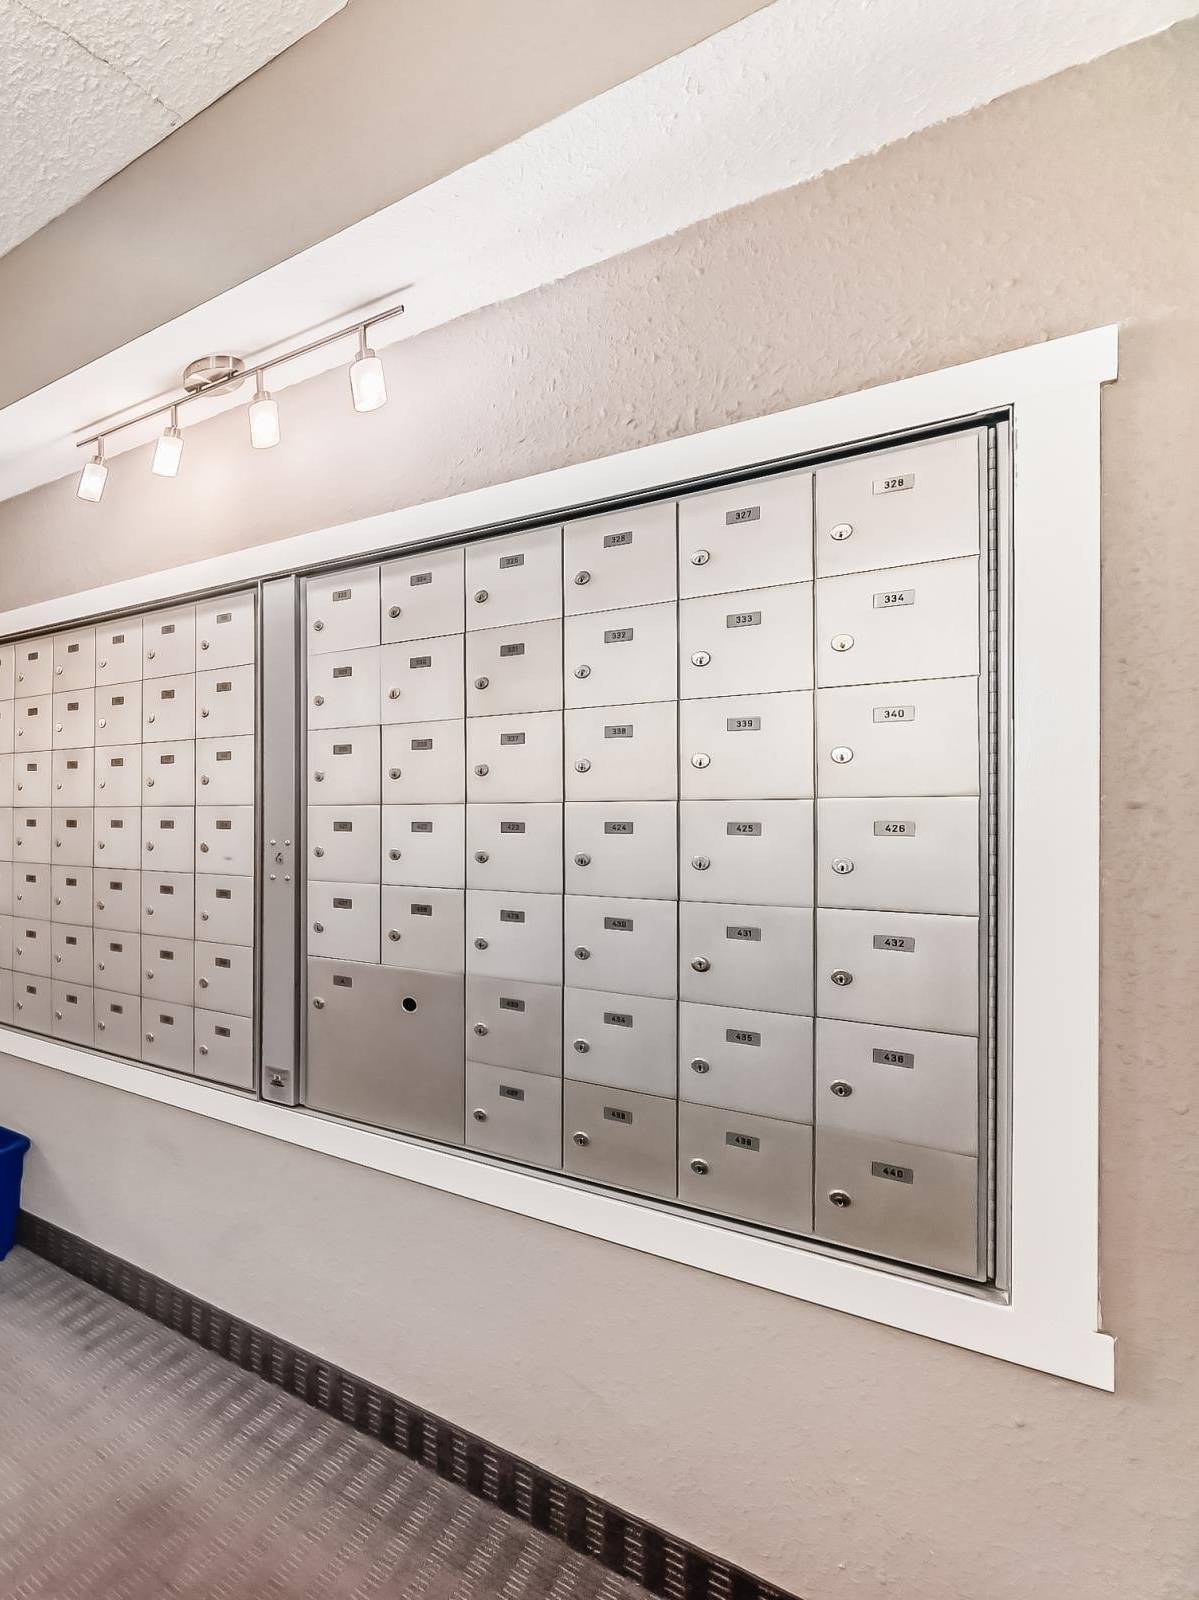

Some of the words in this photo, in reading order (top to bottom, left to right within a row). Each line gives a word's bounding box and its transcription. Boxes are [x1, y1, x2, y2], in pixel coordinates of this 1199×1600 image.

[884, 478, 904, 489] 328
[735, 510, 752, 520] 327
[884, 593, 904, 603] 334
[735, 614, 753, 624] 333
[611, 631, 626, 639] 332
[884, 709, 905, 719] 340
[736, 719, 753, 728] 339
[612, 727, 627, 735] 338
[611, 823, 627, 831] 424
[736, 824, 754, 833] 425
[885, 824, 905, 833] 426
[612, 920, 627, 928] 430
[737, 929, 752, 938] 431
[884, 938, 905, 948] 432
[611, 1016, 626, 1024] 434
[735, 1033, 752, 1042] 435
[884, 1053, 904, 1063] 436
[883, 1167, 903, 1178] 440
